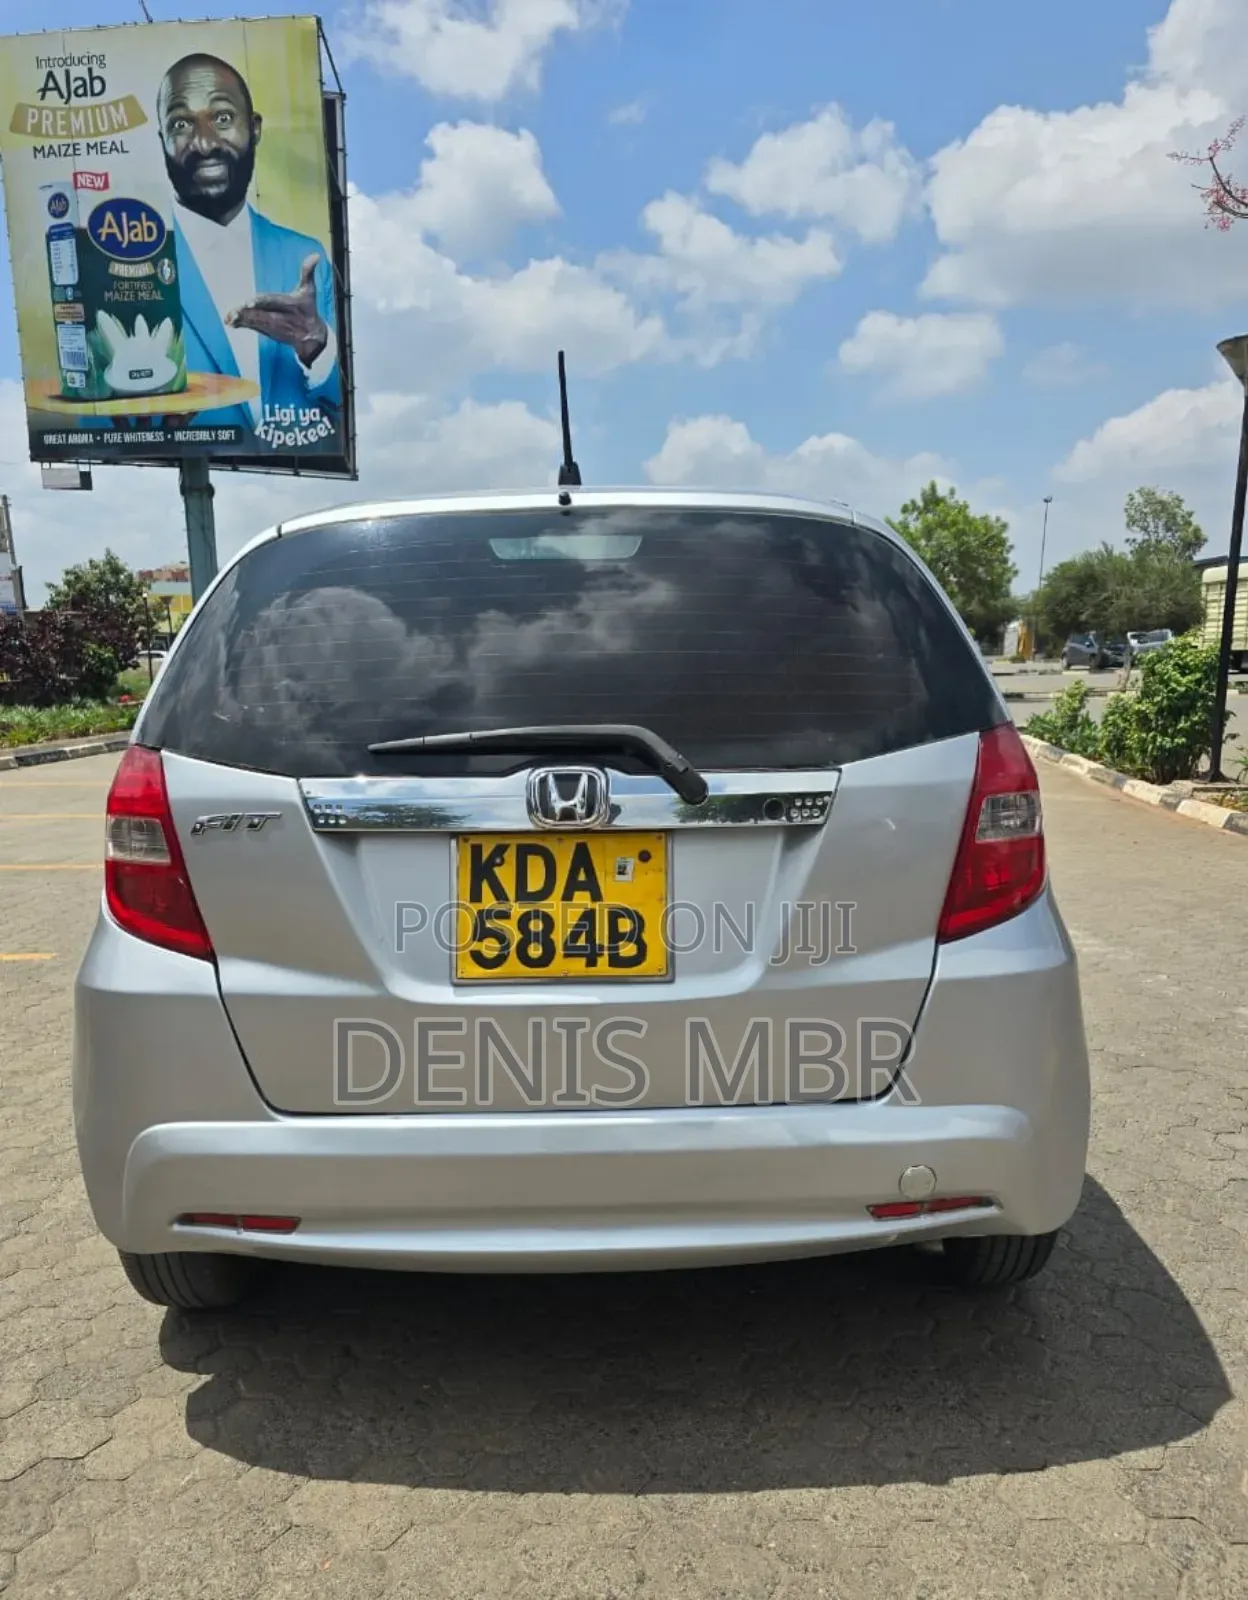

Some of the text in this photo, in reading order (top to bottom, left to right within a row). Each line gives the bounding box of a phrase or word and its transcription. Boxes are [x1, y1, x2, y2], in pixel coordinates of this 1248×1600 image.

[35, 52, 107, 69] Introducing
[27, 101, 129, 135] PREMIUM
[33, 140, 130, 159] MAIZE MEAL
[76, 174, 106, 189] NEW
[104, 289, 164, 301] MAIZE MEAL
[264, 403, 321, 426] Ligi ya
[43, 429, 236, 445] GREAT AROMA PURE WHITENESS INCREDIBLY SOFT
[190, 811, 283, 836] FIT
[469, 841, 604, 903] KDA
[471, 907, 648, 970] 584B
